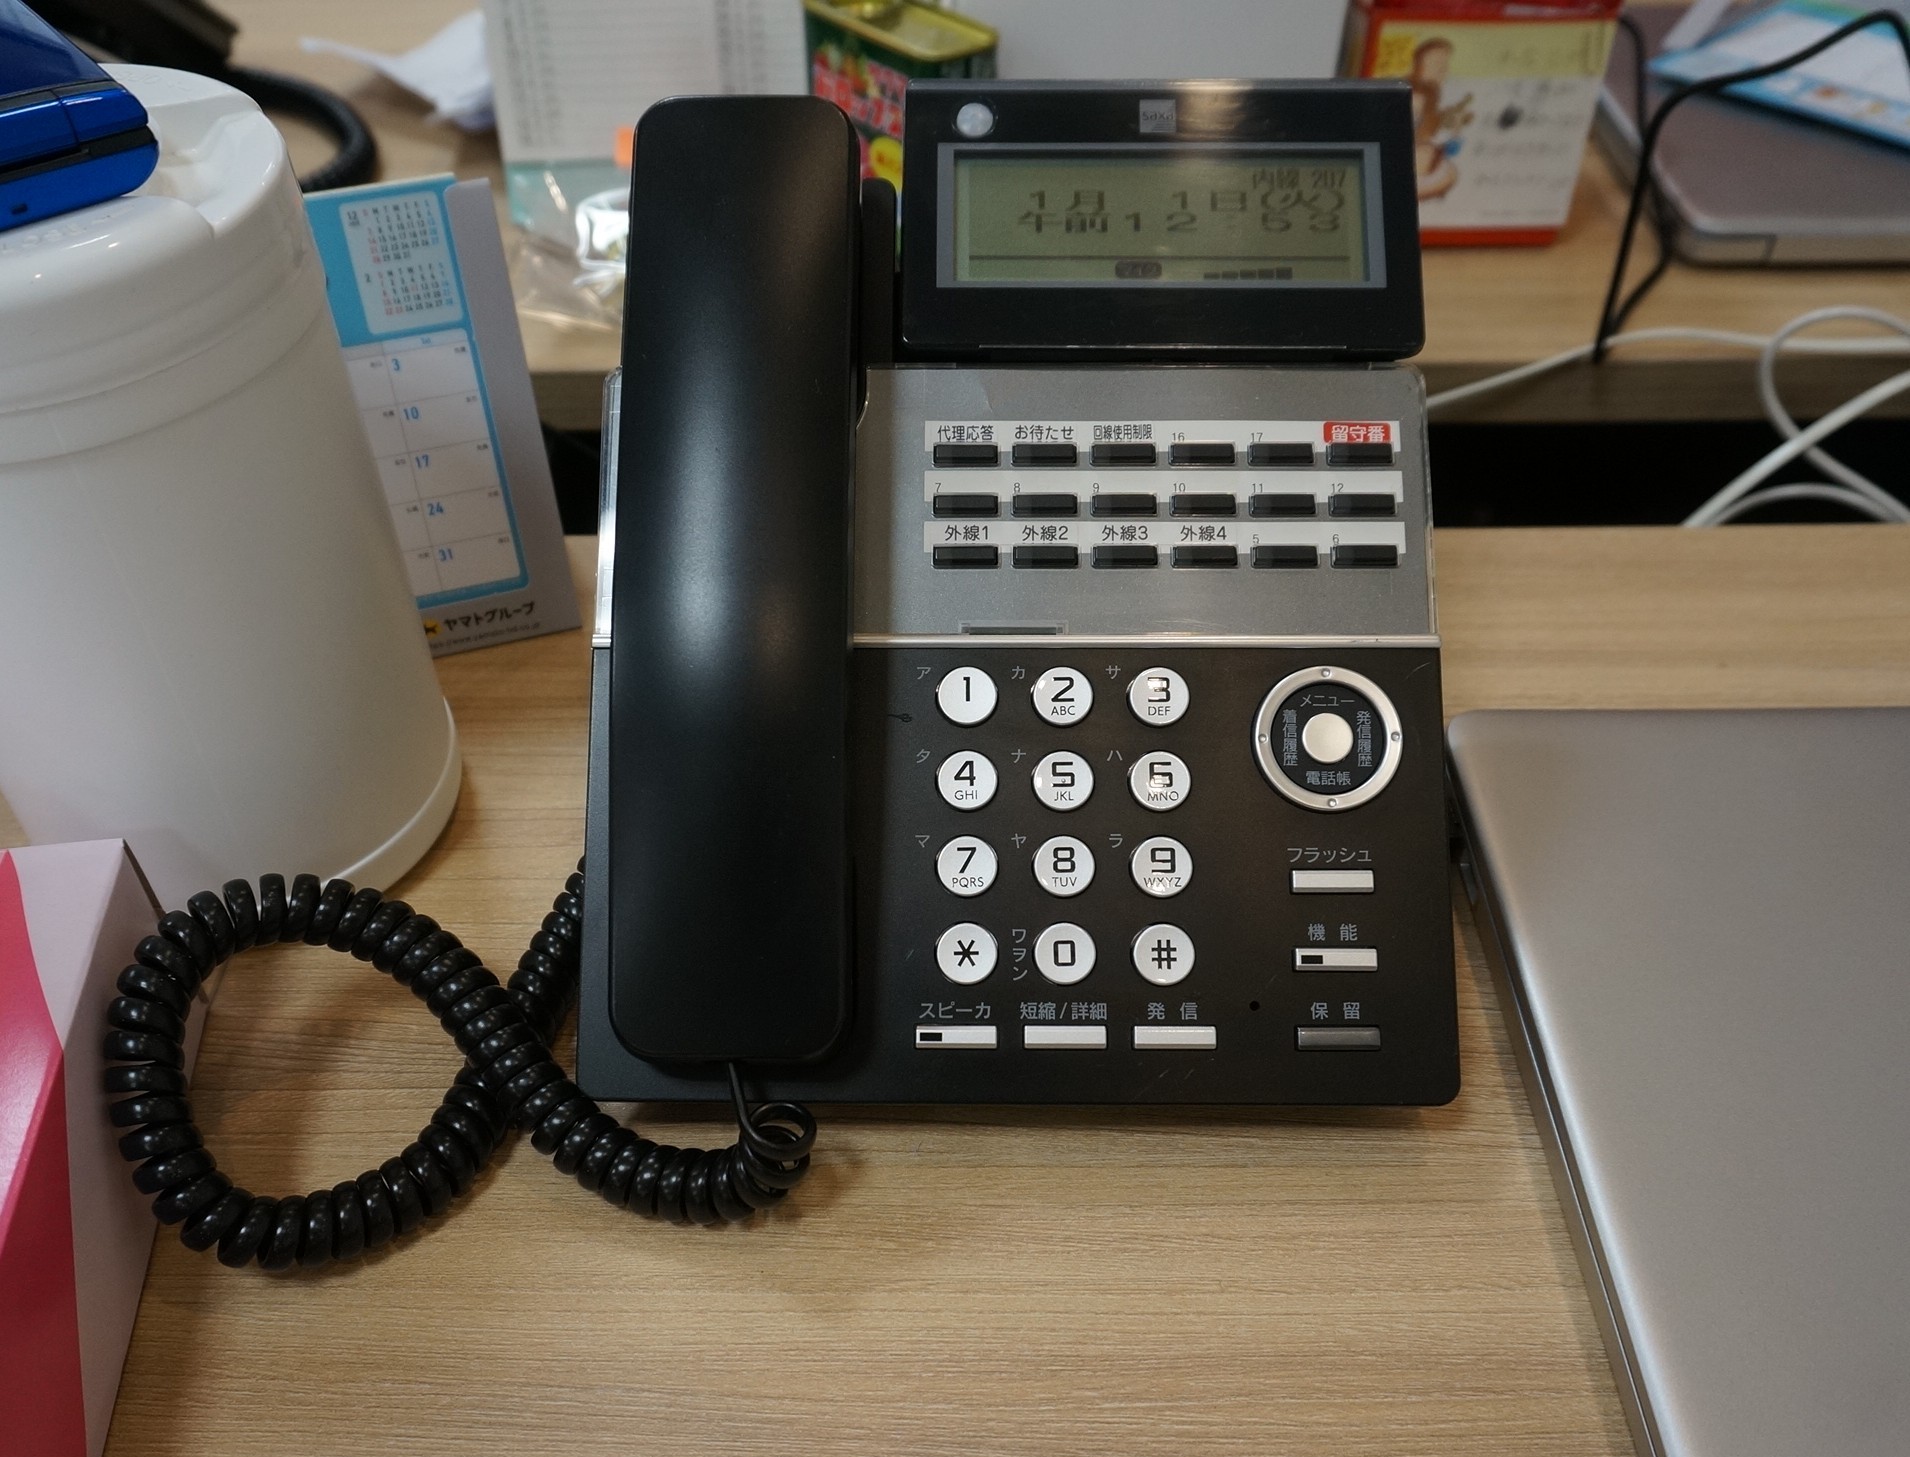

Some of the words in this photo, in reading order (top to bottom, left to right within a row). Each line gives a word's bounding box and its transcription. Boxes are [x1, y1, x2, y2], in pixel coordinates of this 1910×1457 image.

[1142, 111, 1174, 121] saxa
[1030, 189, 1105, 212] 1月
[392, 359, 400, 371] 3
[404, 406, 419, 420] 10
[937, 424, 994, 441] 代理応答
[1014, 425, 1074, 441] お待たせ
[1093, 424, 1152, 440] 回線使用制限
[1171, 432, 1185, 442] 16
[1250, 432, 1263, 442] 17
[1331, 425, 1385, 443] 留守番
[414, 454, 430, 469] 17
[935, 482, 942, 493] 7
[1013, 482, 1021, 493] 8
[1092, 482, 1100, 493] 9
[1173, 482, 1186, 493] 10
[1251, 482, 1264, 493] 11
[1331, 482, 1344, 493] 12
[427, 502, 444, 516] 24
[944, 525, 989, 541] 外線1
[1022, 525, 1069, 541] 外線2
[1102, 525, 1148, 541] 外線3
[1180, 525, 1227, 542] 外線4
[1252, 534, 1260, 544] 5
[1332, 534, 1340, 544] 6
[438, 548, 453, 562] 31
[916, 666, 931, 680] ア
[1105, 665, 1121, 680] サ
[963, 676, 971, 702] 1
[1051, 676, 1075, 703] 2
[1147, 676, 1171, 703] 3
[1300, 694, 1355, 707] メニュー
[1050, 705, 1076, 716] ABC
[1147, 705, 1171, 716] DEF
[1282, 709, 1298, 766] 着信履歴
[1356, 711, 1372, 767] 発信履歴
[916, 749, 931, 763] タ
[1011, 749, 1027, 763] ナ
[953, 760, 976, 786] 4
[1051, 761, 1075, 787] 5
[1148, 761, 1173, 788] 6
[1305, 771, 1351, 786] 電話帳
[954, 790, 978, 801] GHI
[1054, 791, 1075, 802] JKL
[1147, 791, 1179, 802] MNO
[914, 834, 930, 848] マ
[1011, 833, 1027, 849] ヤ
[1108, 833, 1123, 848] ラ
[956, 847, 977, 874] 7
[1052, 847, 1076, 873] 8
[1150, 847, 1176, 873] 9
[1287, 847, 1372, 863] フラッシュ
[952, 877, 985, 889] PQRS
[1051, 877, 1077, 887] TUV
[1143, 877, 1182, 888] WXYZ
[1307, 923, 1358, 941] 機能
[1053, 940, 1075, 966] 0
[1151, 939, 1177, 969] #
[919, 1002, 991, 1020] スピーカ
[1310, 1002, 1360, 1020] 保留
